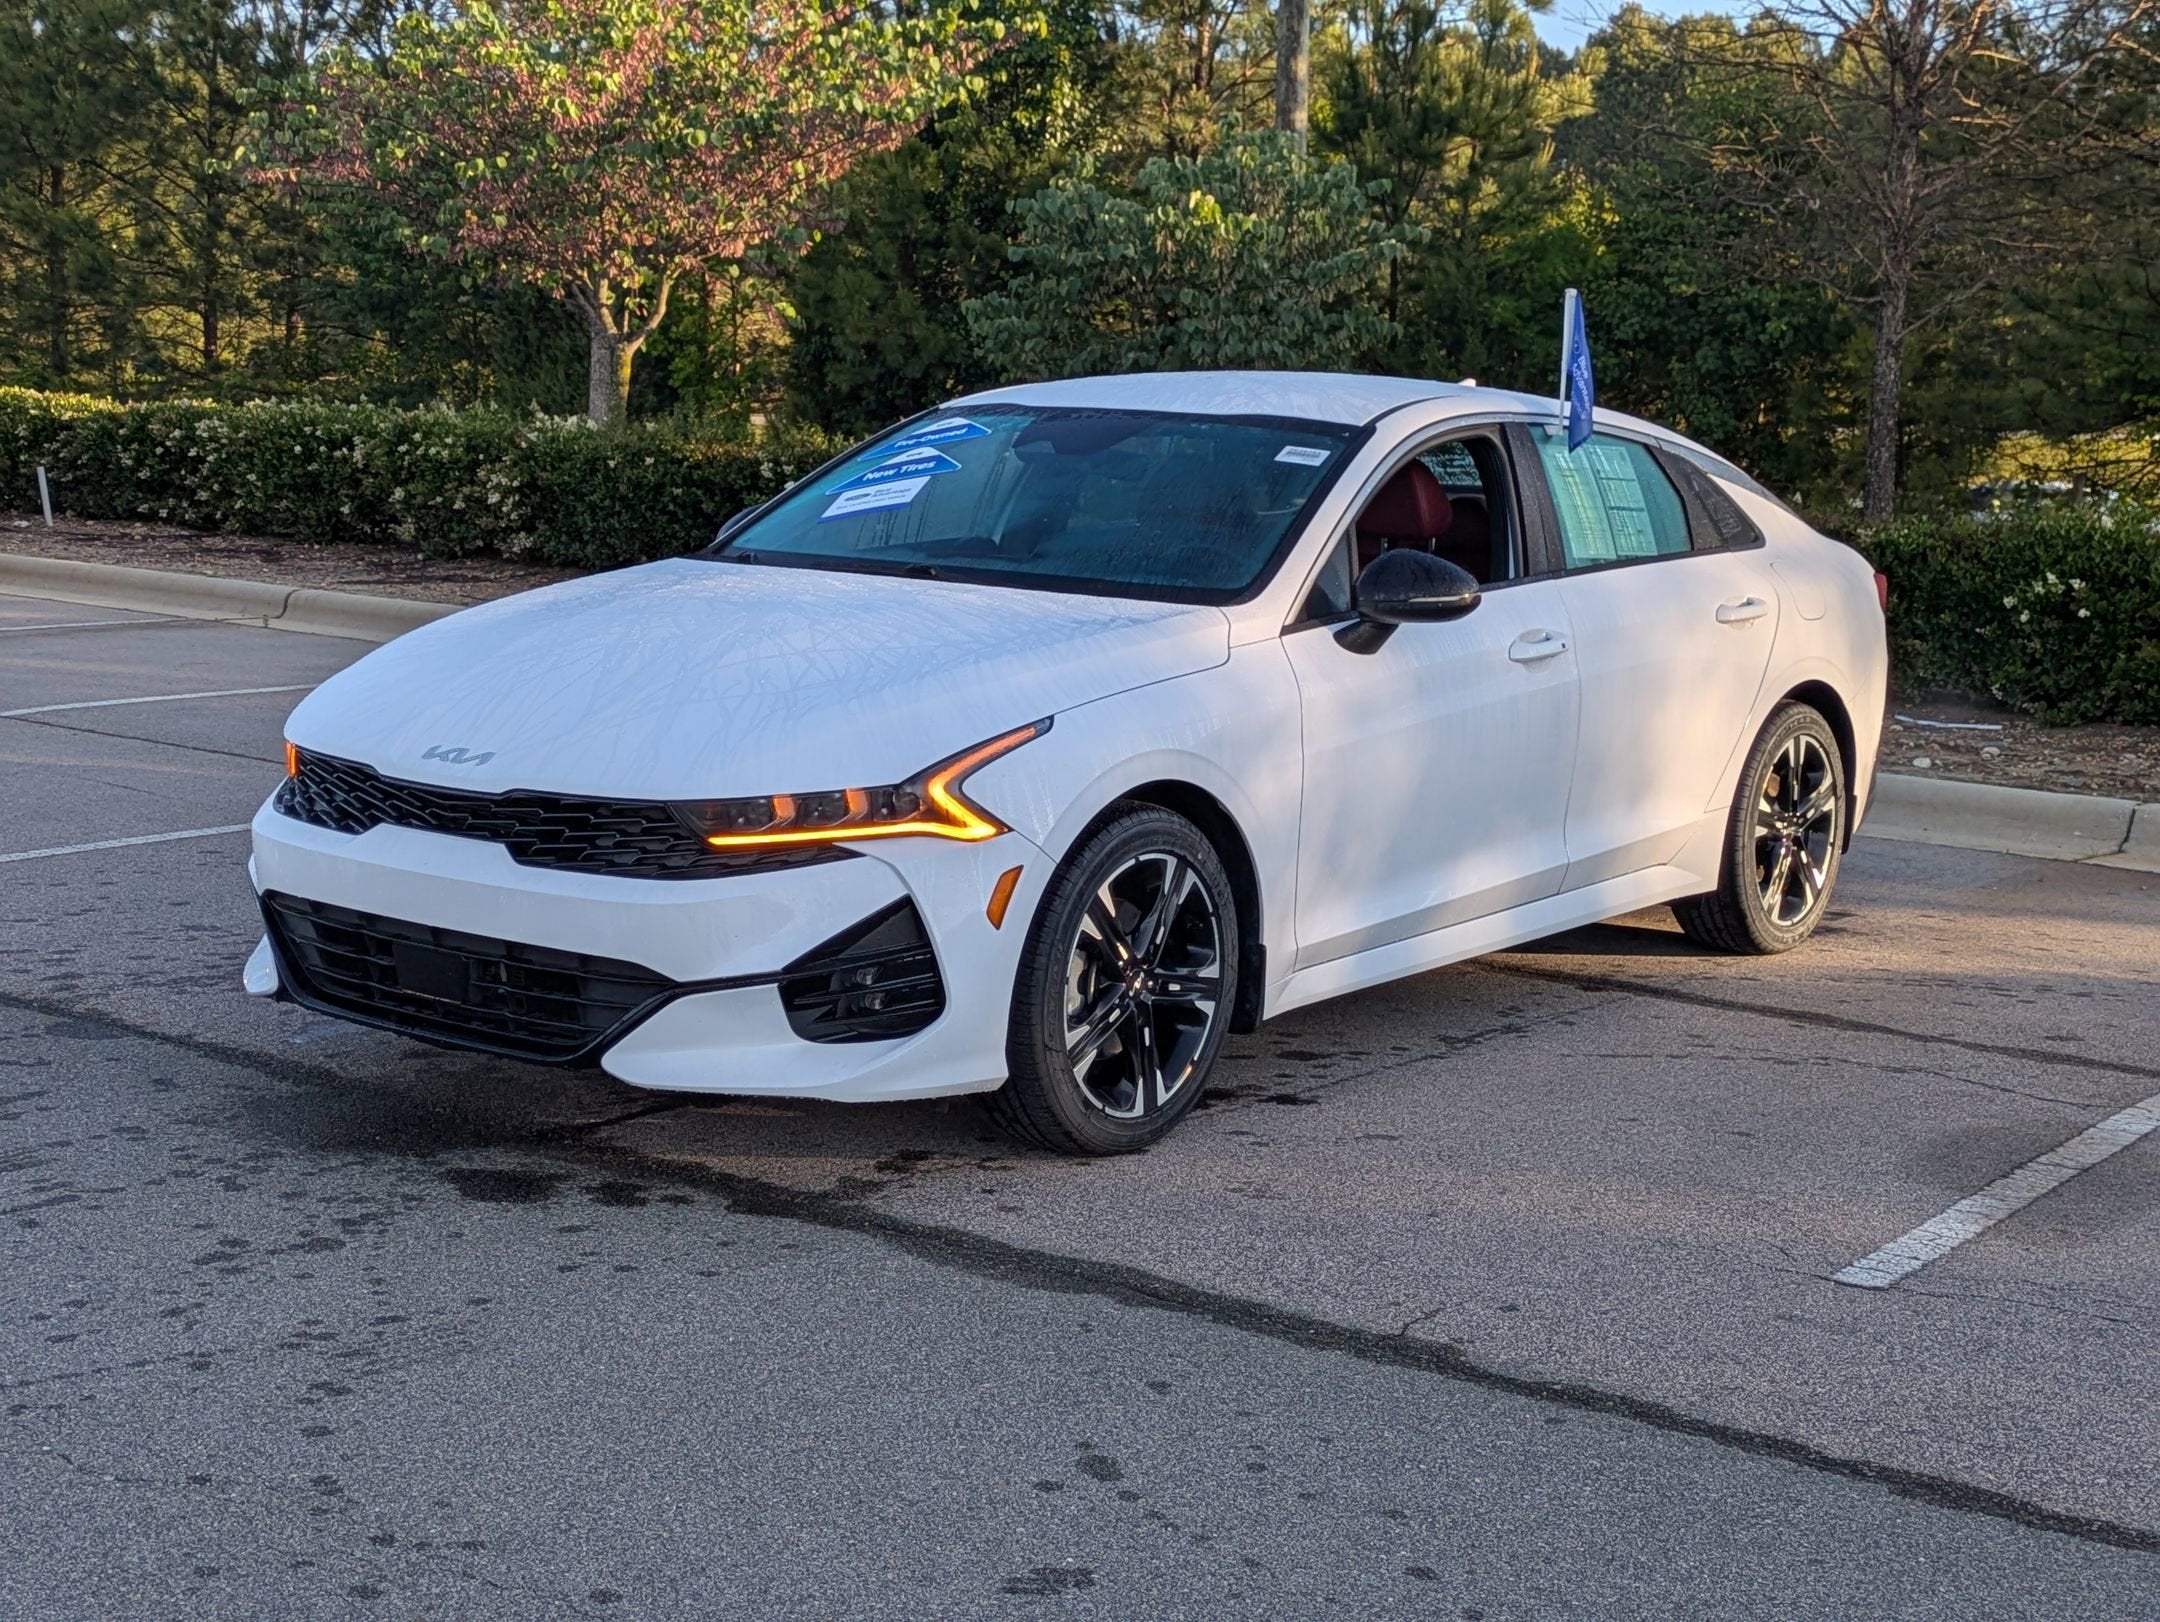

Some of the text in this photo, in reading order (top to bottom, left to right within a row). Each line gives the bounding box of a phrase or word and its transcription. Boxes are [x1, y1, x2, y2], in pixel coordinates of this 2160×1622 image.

[1577, 355, 1588, 379] Blue
[894, 427, 969, 447] Pre-Owned
[862, 461, 937, 481] New Tires
